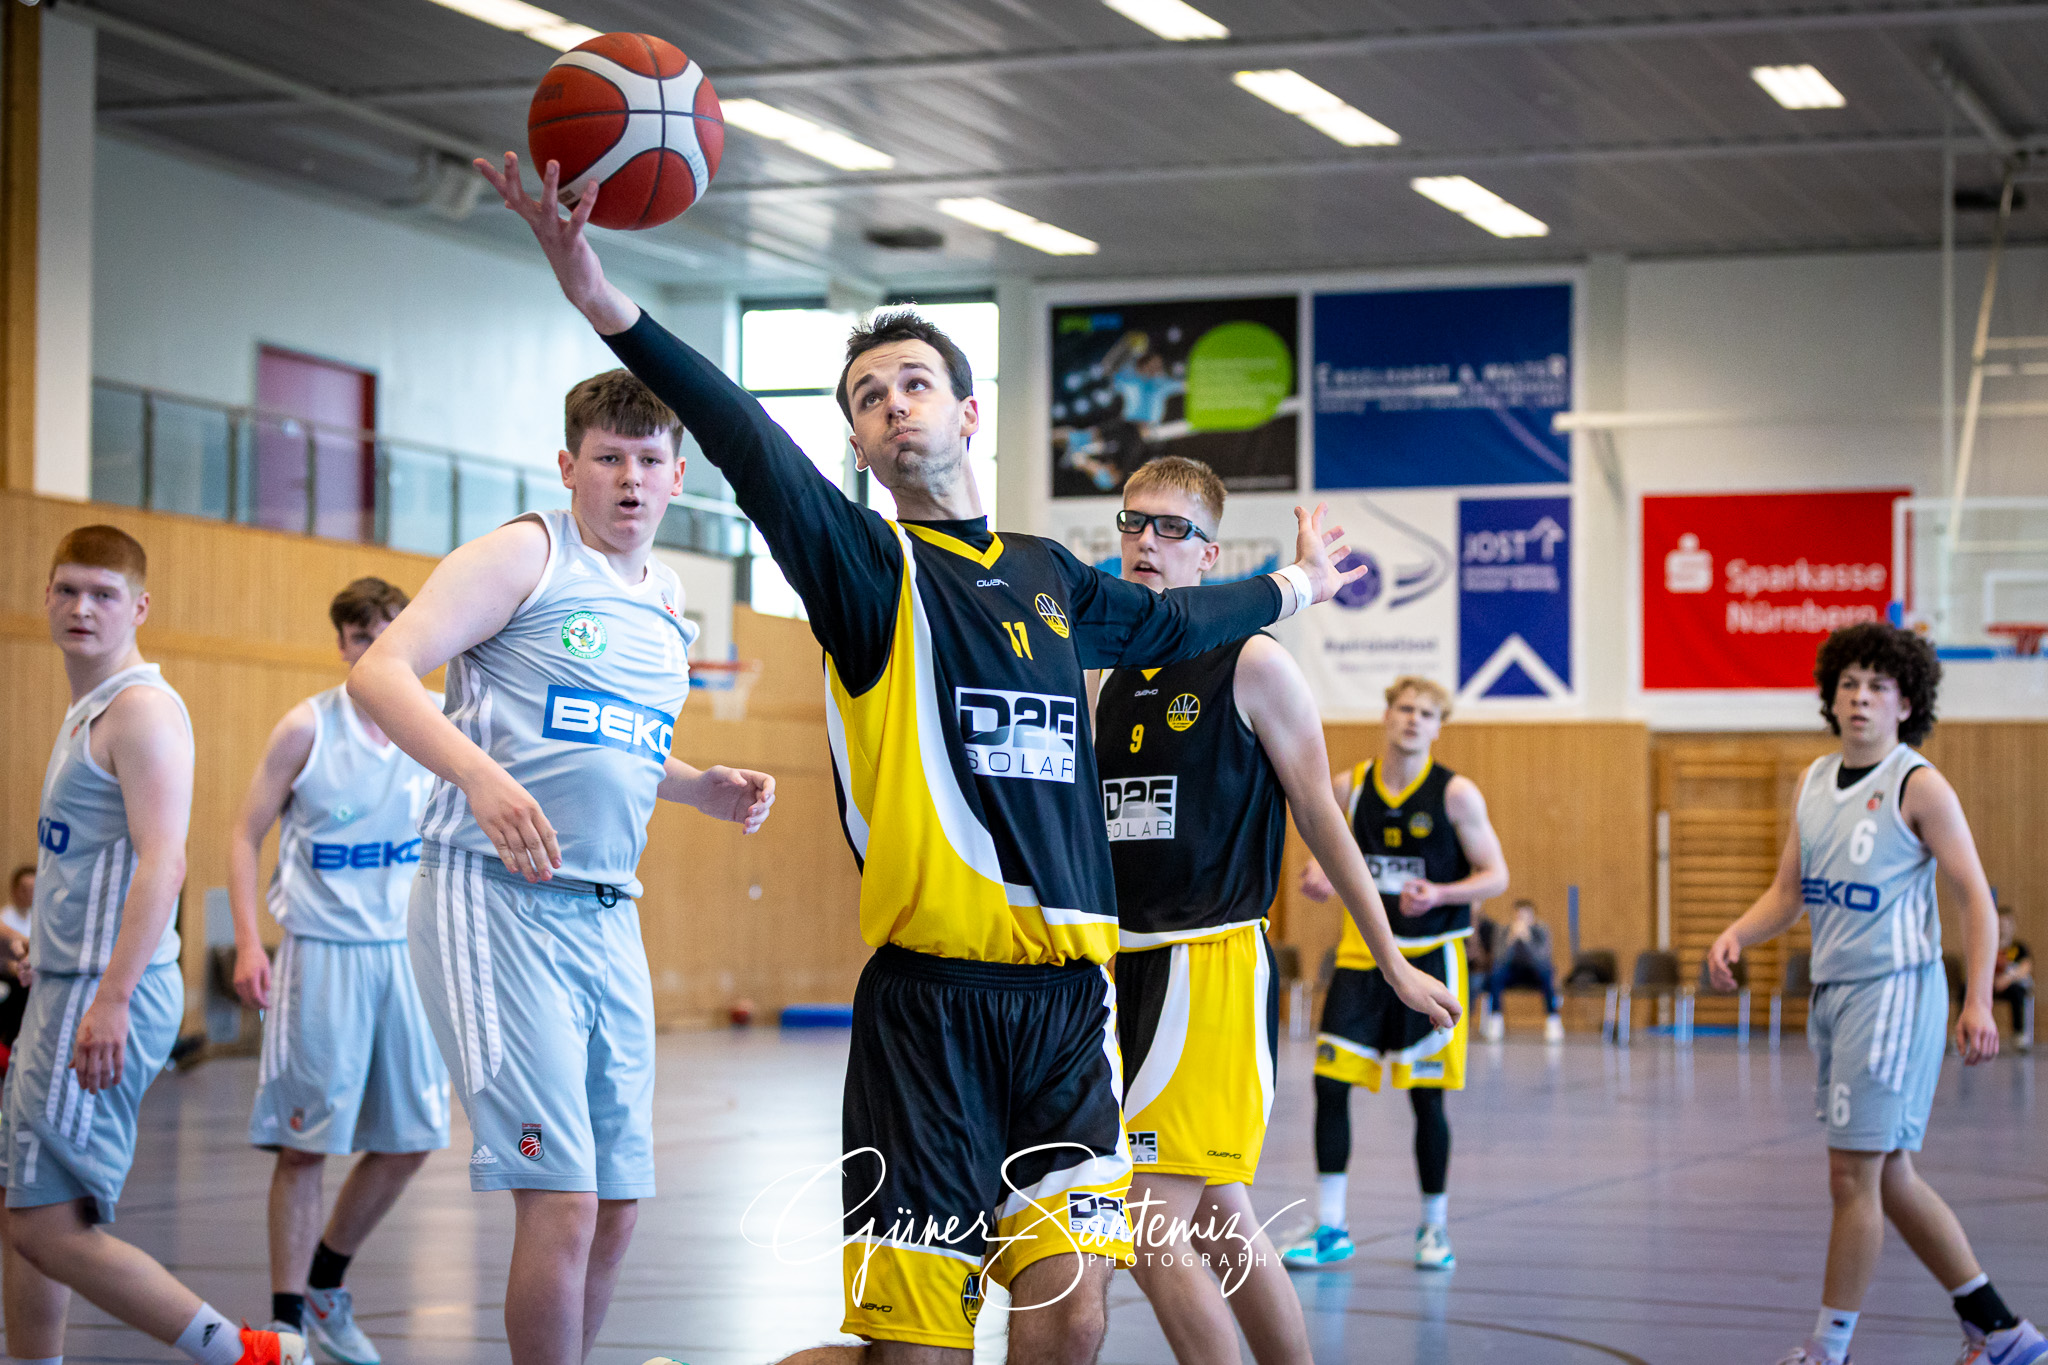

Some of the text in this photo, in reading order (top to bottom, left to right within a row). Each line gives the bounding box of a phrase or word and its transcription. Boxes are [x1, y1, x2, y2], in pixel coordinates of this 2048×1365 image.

[1725, 557, 1887, 600] Sparkasse
[1001, 621, 1034, 661] 11
[551, 695, 673, 757] BEKO
[1129, 724, 1145, 754] 9
[966, 749, 1075, 778] SOLAR
[1107, 821, 1172, 839] SOLAR
[1849, 818, 1878, 865] 6
[1801, 878, 1880, 913] EKO
[1830, 1083, 1850, 1127] 6
[15, 1130, 40, 1183] 7
